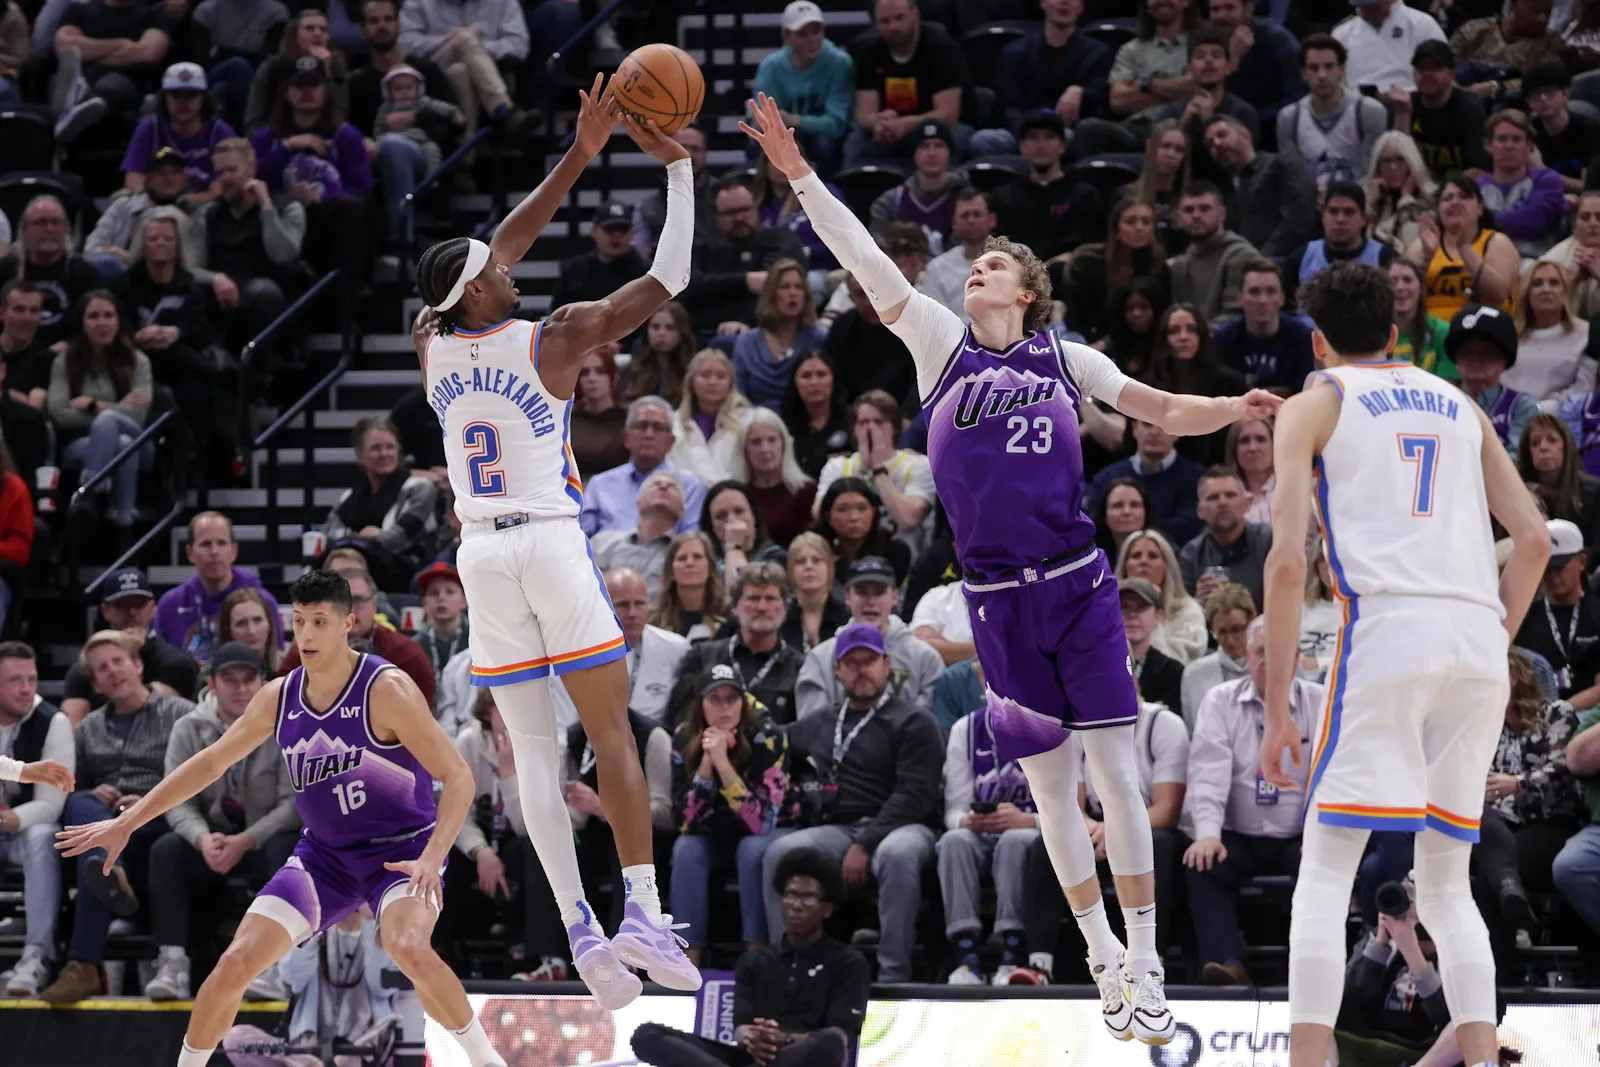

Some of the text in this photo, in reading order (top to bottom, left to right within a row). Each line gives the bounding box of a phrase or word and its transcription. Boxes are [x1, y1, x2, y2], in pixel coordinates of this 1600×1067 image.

[1357, 387, 1459, 422] HOLMGREN
[1005, 415, 1053, 454] 23
[462, 421, 507, 498] 2
[1396, 432, 1441, 517] 7
[340, 706, 361, 718] LVT
[332, 780, 367, 815] 16
